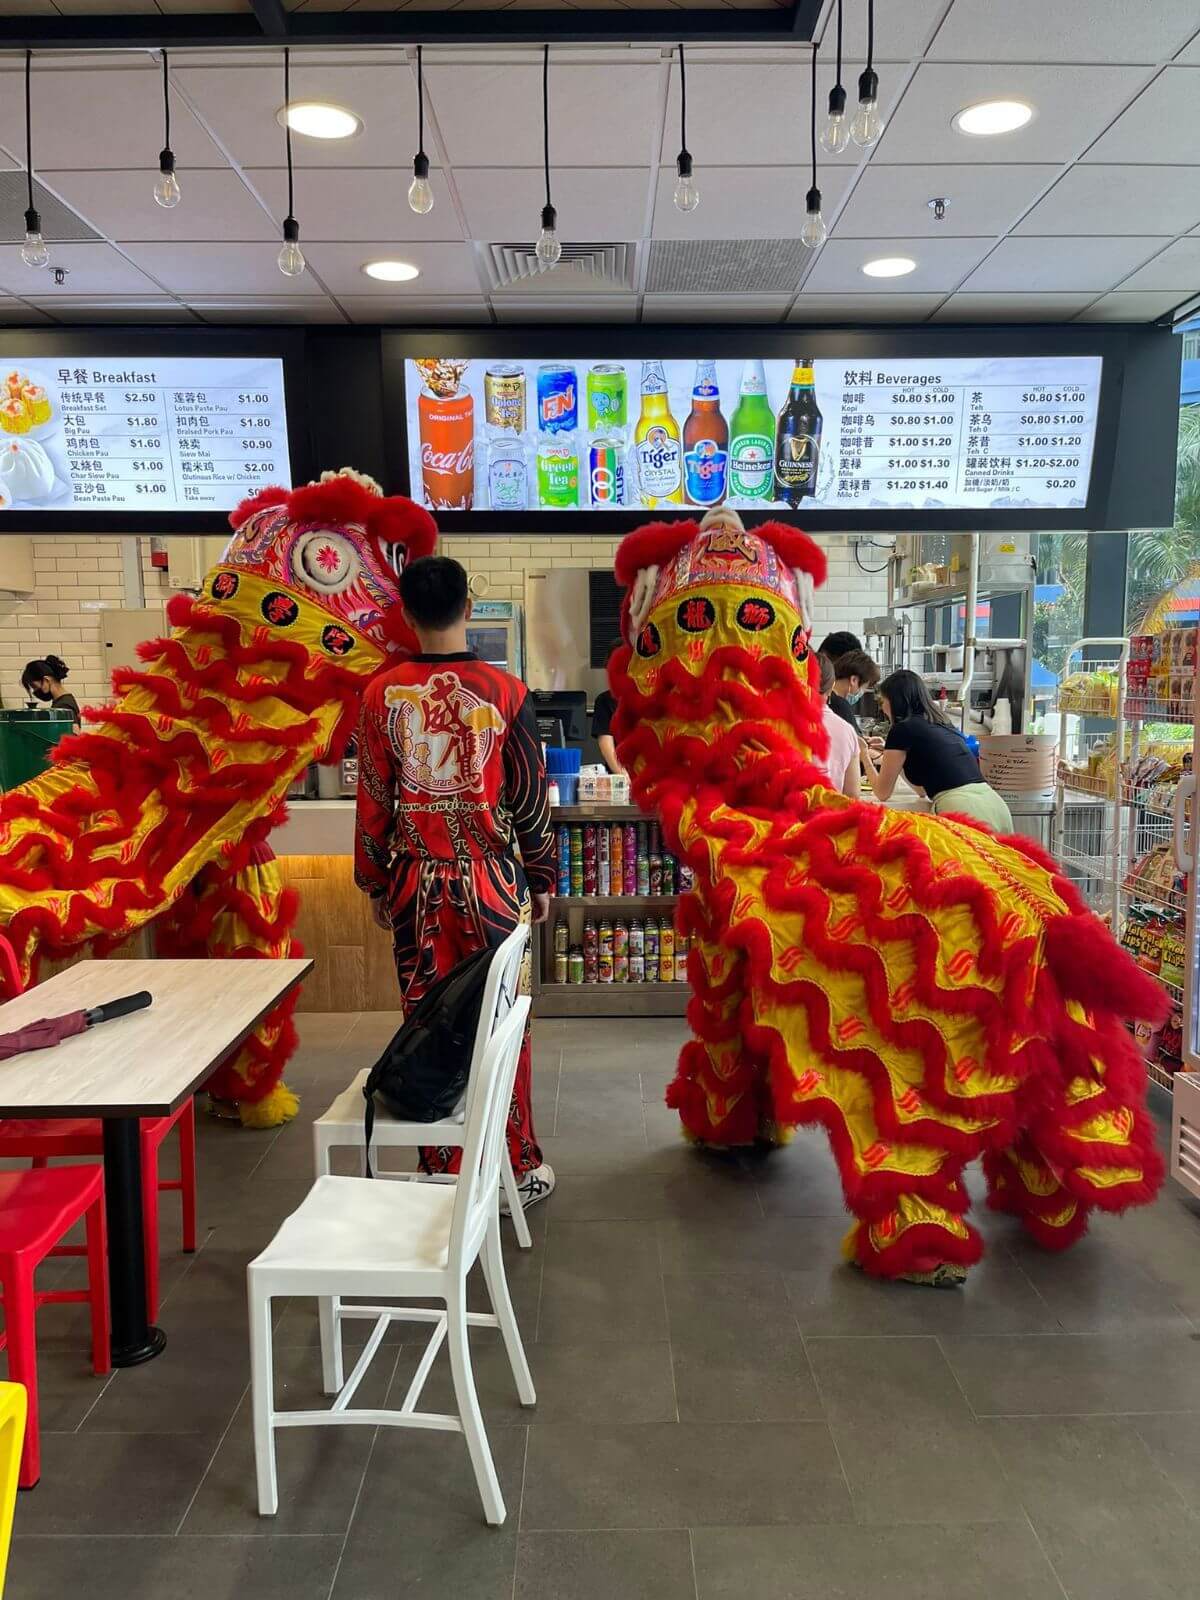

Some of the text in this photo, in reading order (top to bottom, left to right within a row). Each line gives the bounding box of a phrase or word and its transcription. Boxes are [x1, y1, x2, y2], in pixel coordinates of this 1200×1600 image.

[58, 368, 157, 384] 早餐 Breakfast
[844, 370, 942, 386] 饮料 Beverages
[61, 391, 156, 404] 传统早餐 $2.50
[173, 392, 269, 403] 莲蓉包 $1.00
[842, 392, 955, 404] 咖啡 $0.80 $1.00
[971, 392, 1086, 403] 茶 $0.80 $1.00
[841, 404, 857, 412] Kopi
[64, 415, 158, 426] 大包 $1.80
[176, 416, 271, 427] 扣肉包 $1.80
[429, 413, 464, 422] ORIGINAL
[841, 414, 954, 426] 咖啡乌 $0.80 $1.00
[970, 413, 1084, 425] 茶乌 $0.80 $1.00
[65, 427, 76, 435] Big
[66, 438, 161, 449] 鸡肉包 $1.60
[178, 438, 272, 449] 烧卖 $0.90
[840, 436, 952, 448] 咖啡昔 $1.00 $1.20
[968, 435, 1082, 447] 茶昔 $1.00 $1.20
[839, 448, 856, 456] Kopi
[641, 448, 677, 469] Tiger
[778, 460, 814, 468] GUINNESS
[839, 458, 950, 469] 美禄 $1.00 $1.30
[966, 457, 1079, 469] 罐装饮料 $1.20-$2.00
[70, 460, 163, 471] 叉烧包 $1.00
[244, 463, 274, 472] $2.00
[541, 459, 575, 473] Green
[688, 459, 725, 480] Tiger
[732, 461, 772, 471] Heineken
[549, 472, 569, 485] Tea
[644, 469, 675, 477] CRYSTAL
[73, 483, 166, 494] 豆沙包 $1.00
[838, 479, 948, 491] 美禄昔 $1.20 $1.40
[1046, 479, 1077, 488] $0.20
[683, 600, 711, 628] 龍
